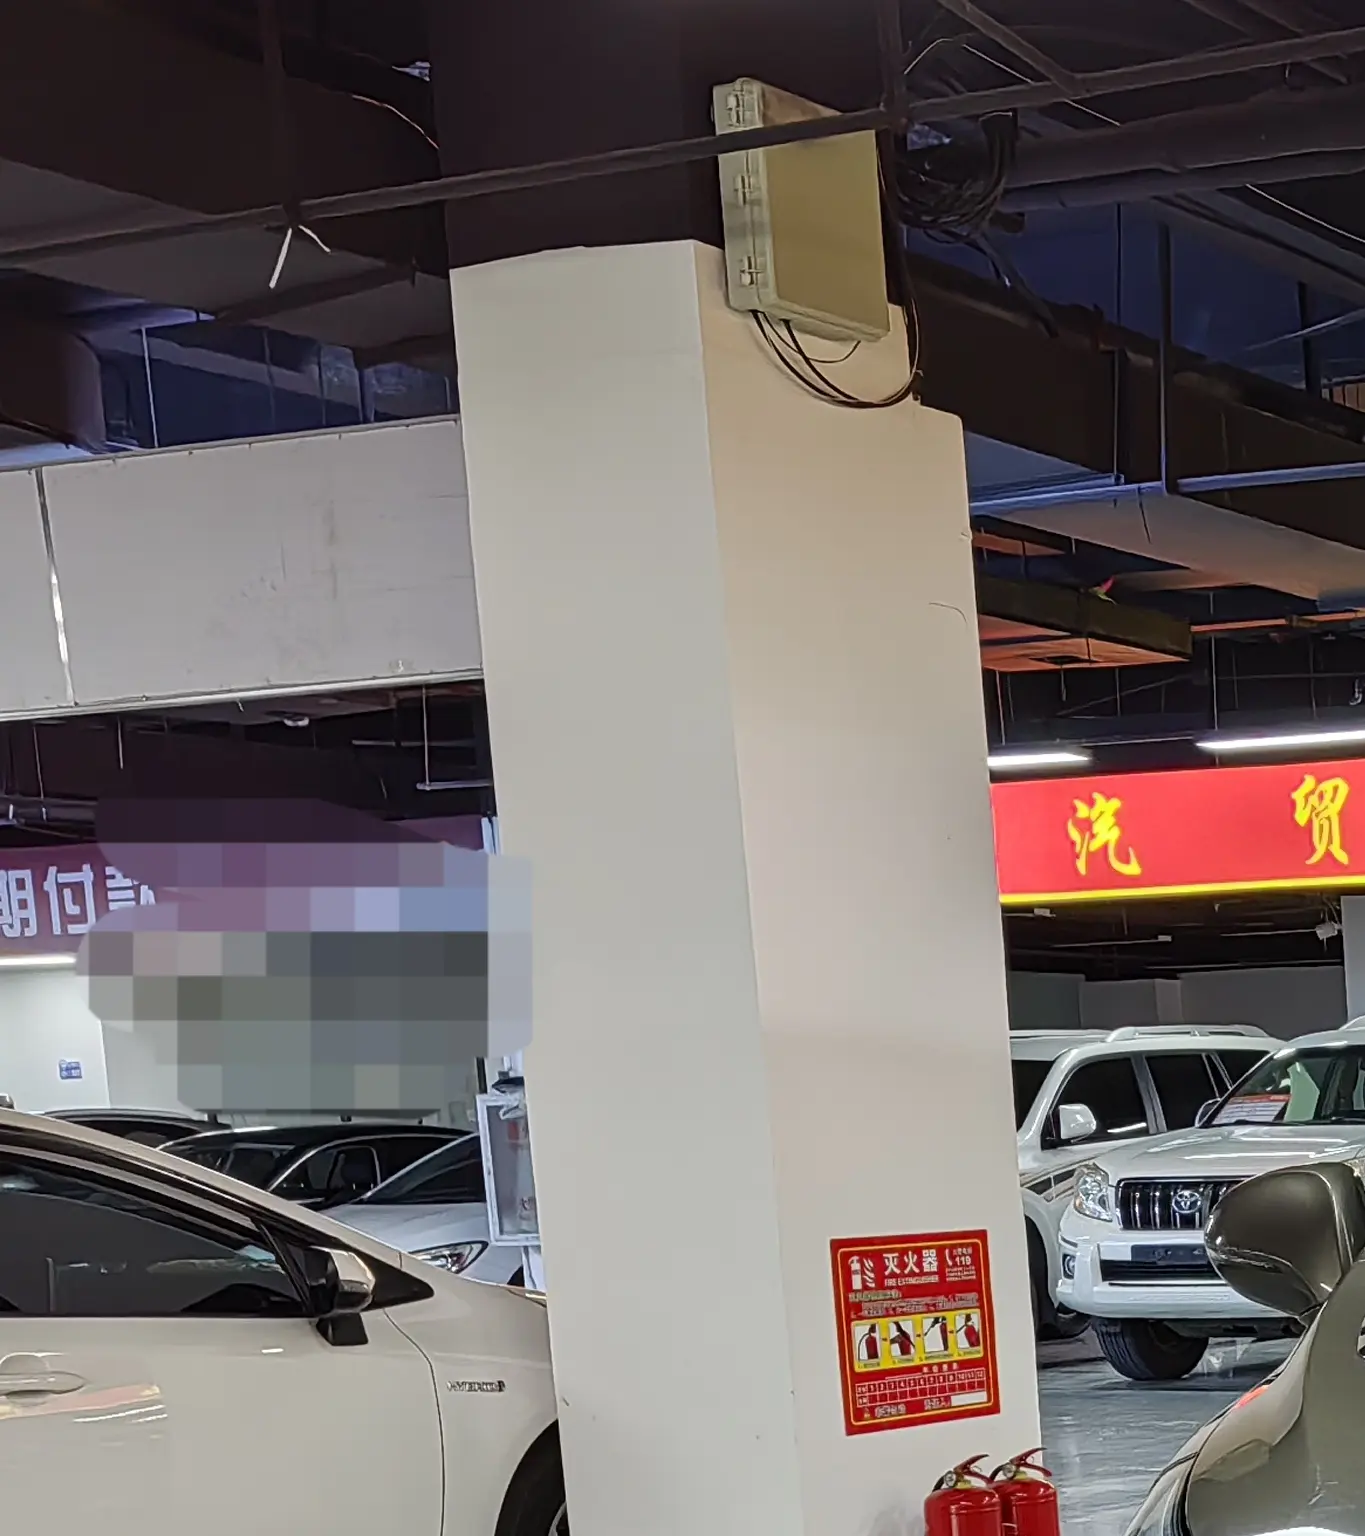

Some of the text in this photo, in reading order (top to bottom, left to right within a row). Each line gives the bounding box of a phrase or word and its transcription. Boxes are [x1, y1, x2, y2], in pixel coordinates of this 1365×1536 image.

[883, 1248, 938, 1276] 灭火器
[955, 1255, 972, 1266] 119
